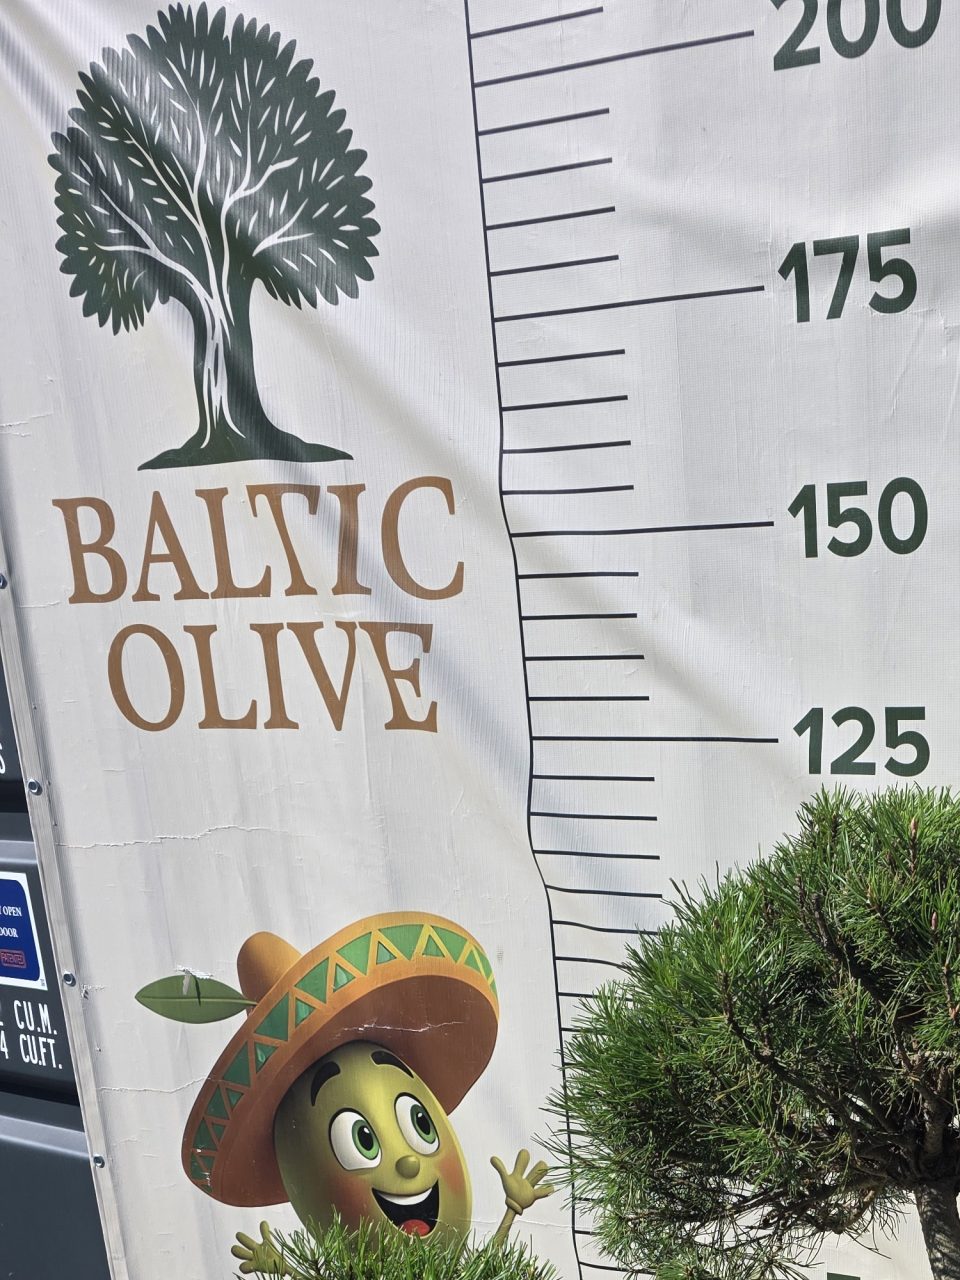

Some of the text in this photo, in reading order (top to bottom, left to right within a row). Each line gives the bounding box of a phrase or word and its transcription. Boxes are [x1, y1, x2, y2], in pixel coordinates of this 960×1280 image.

[770, 0, 942, 71] 200
[777, 227, 918, 323] 175
[52, 475, 465, 605] BALTIC
[787, 476, 929, 558] 150
[107, 620, 438, 733] OLIVE
[792, 706, 931, 777] 125
[13, 999, 58, 1035] CU.M.
